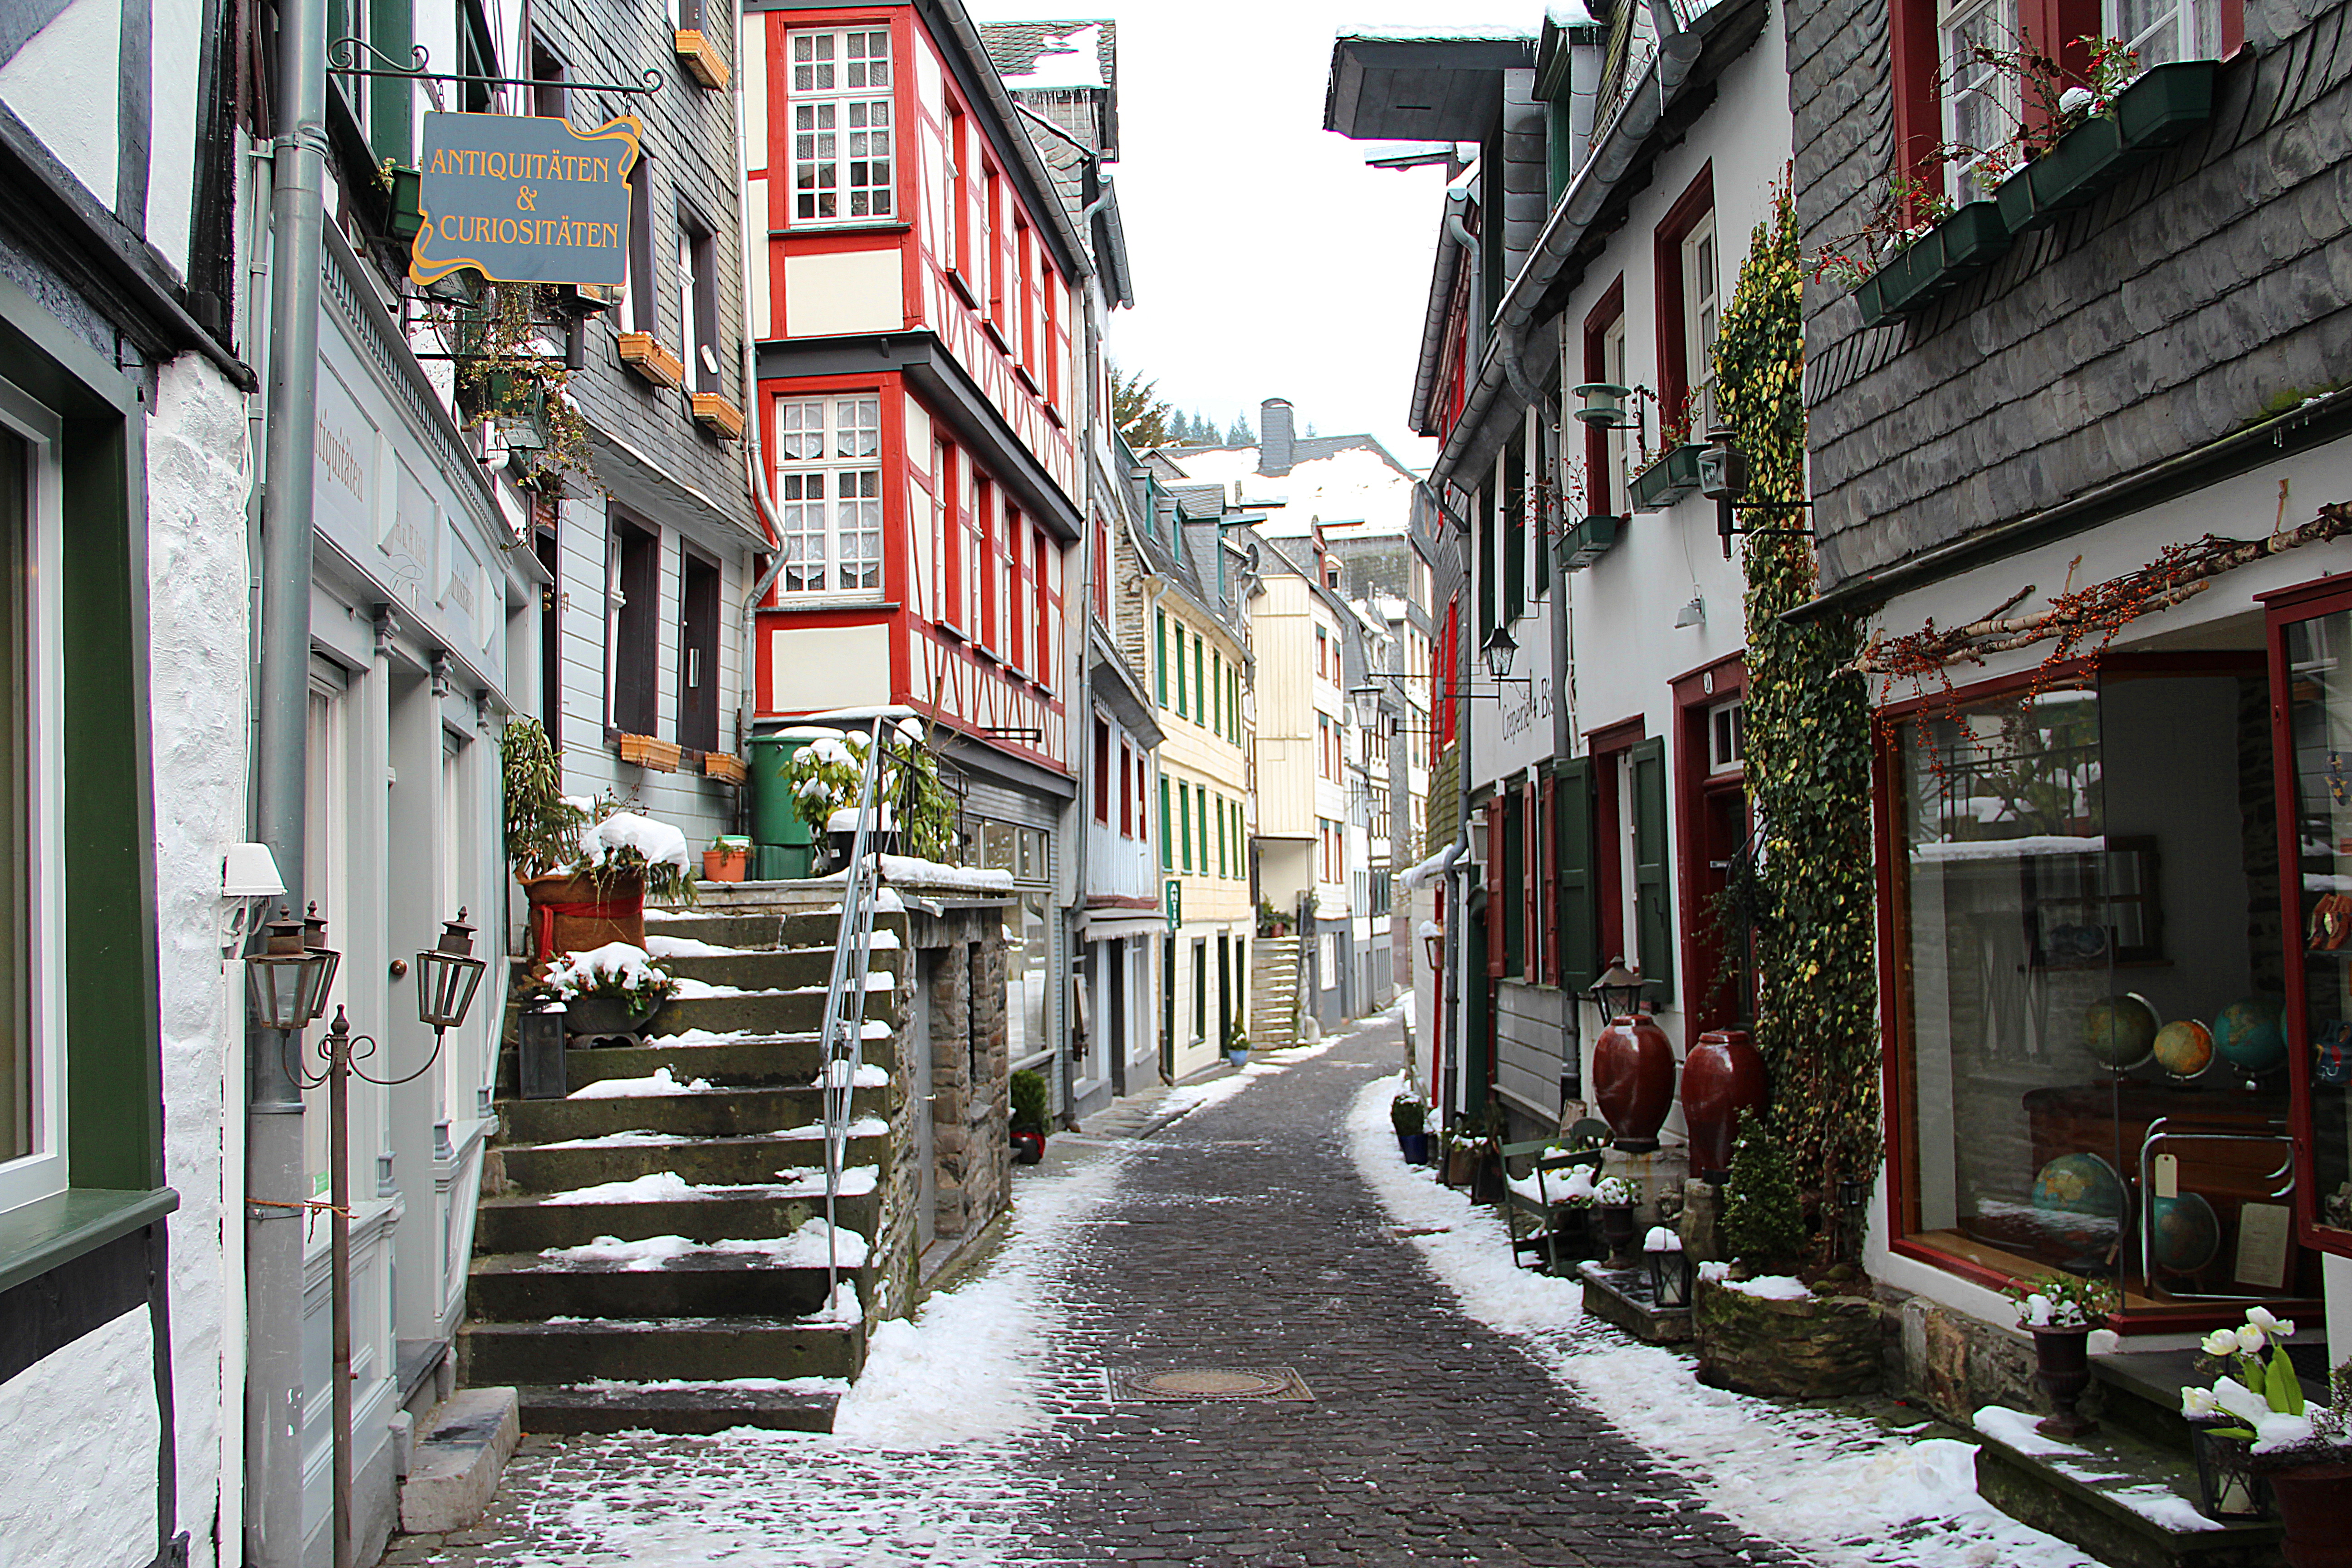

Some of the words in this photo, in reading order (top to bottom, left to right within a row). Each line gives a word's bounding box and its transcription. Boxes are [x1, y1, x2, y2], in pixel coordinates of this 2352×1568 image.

[429, 149, 609, 182] ANTIQUITÄTEN
[516, 185, 537, 211] &
[440, 215, 618, 249] CURIOSITÄTEN
[1170, 883, 1179, 929] ANTIK
